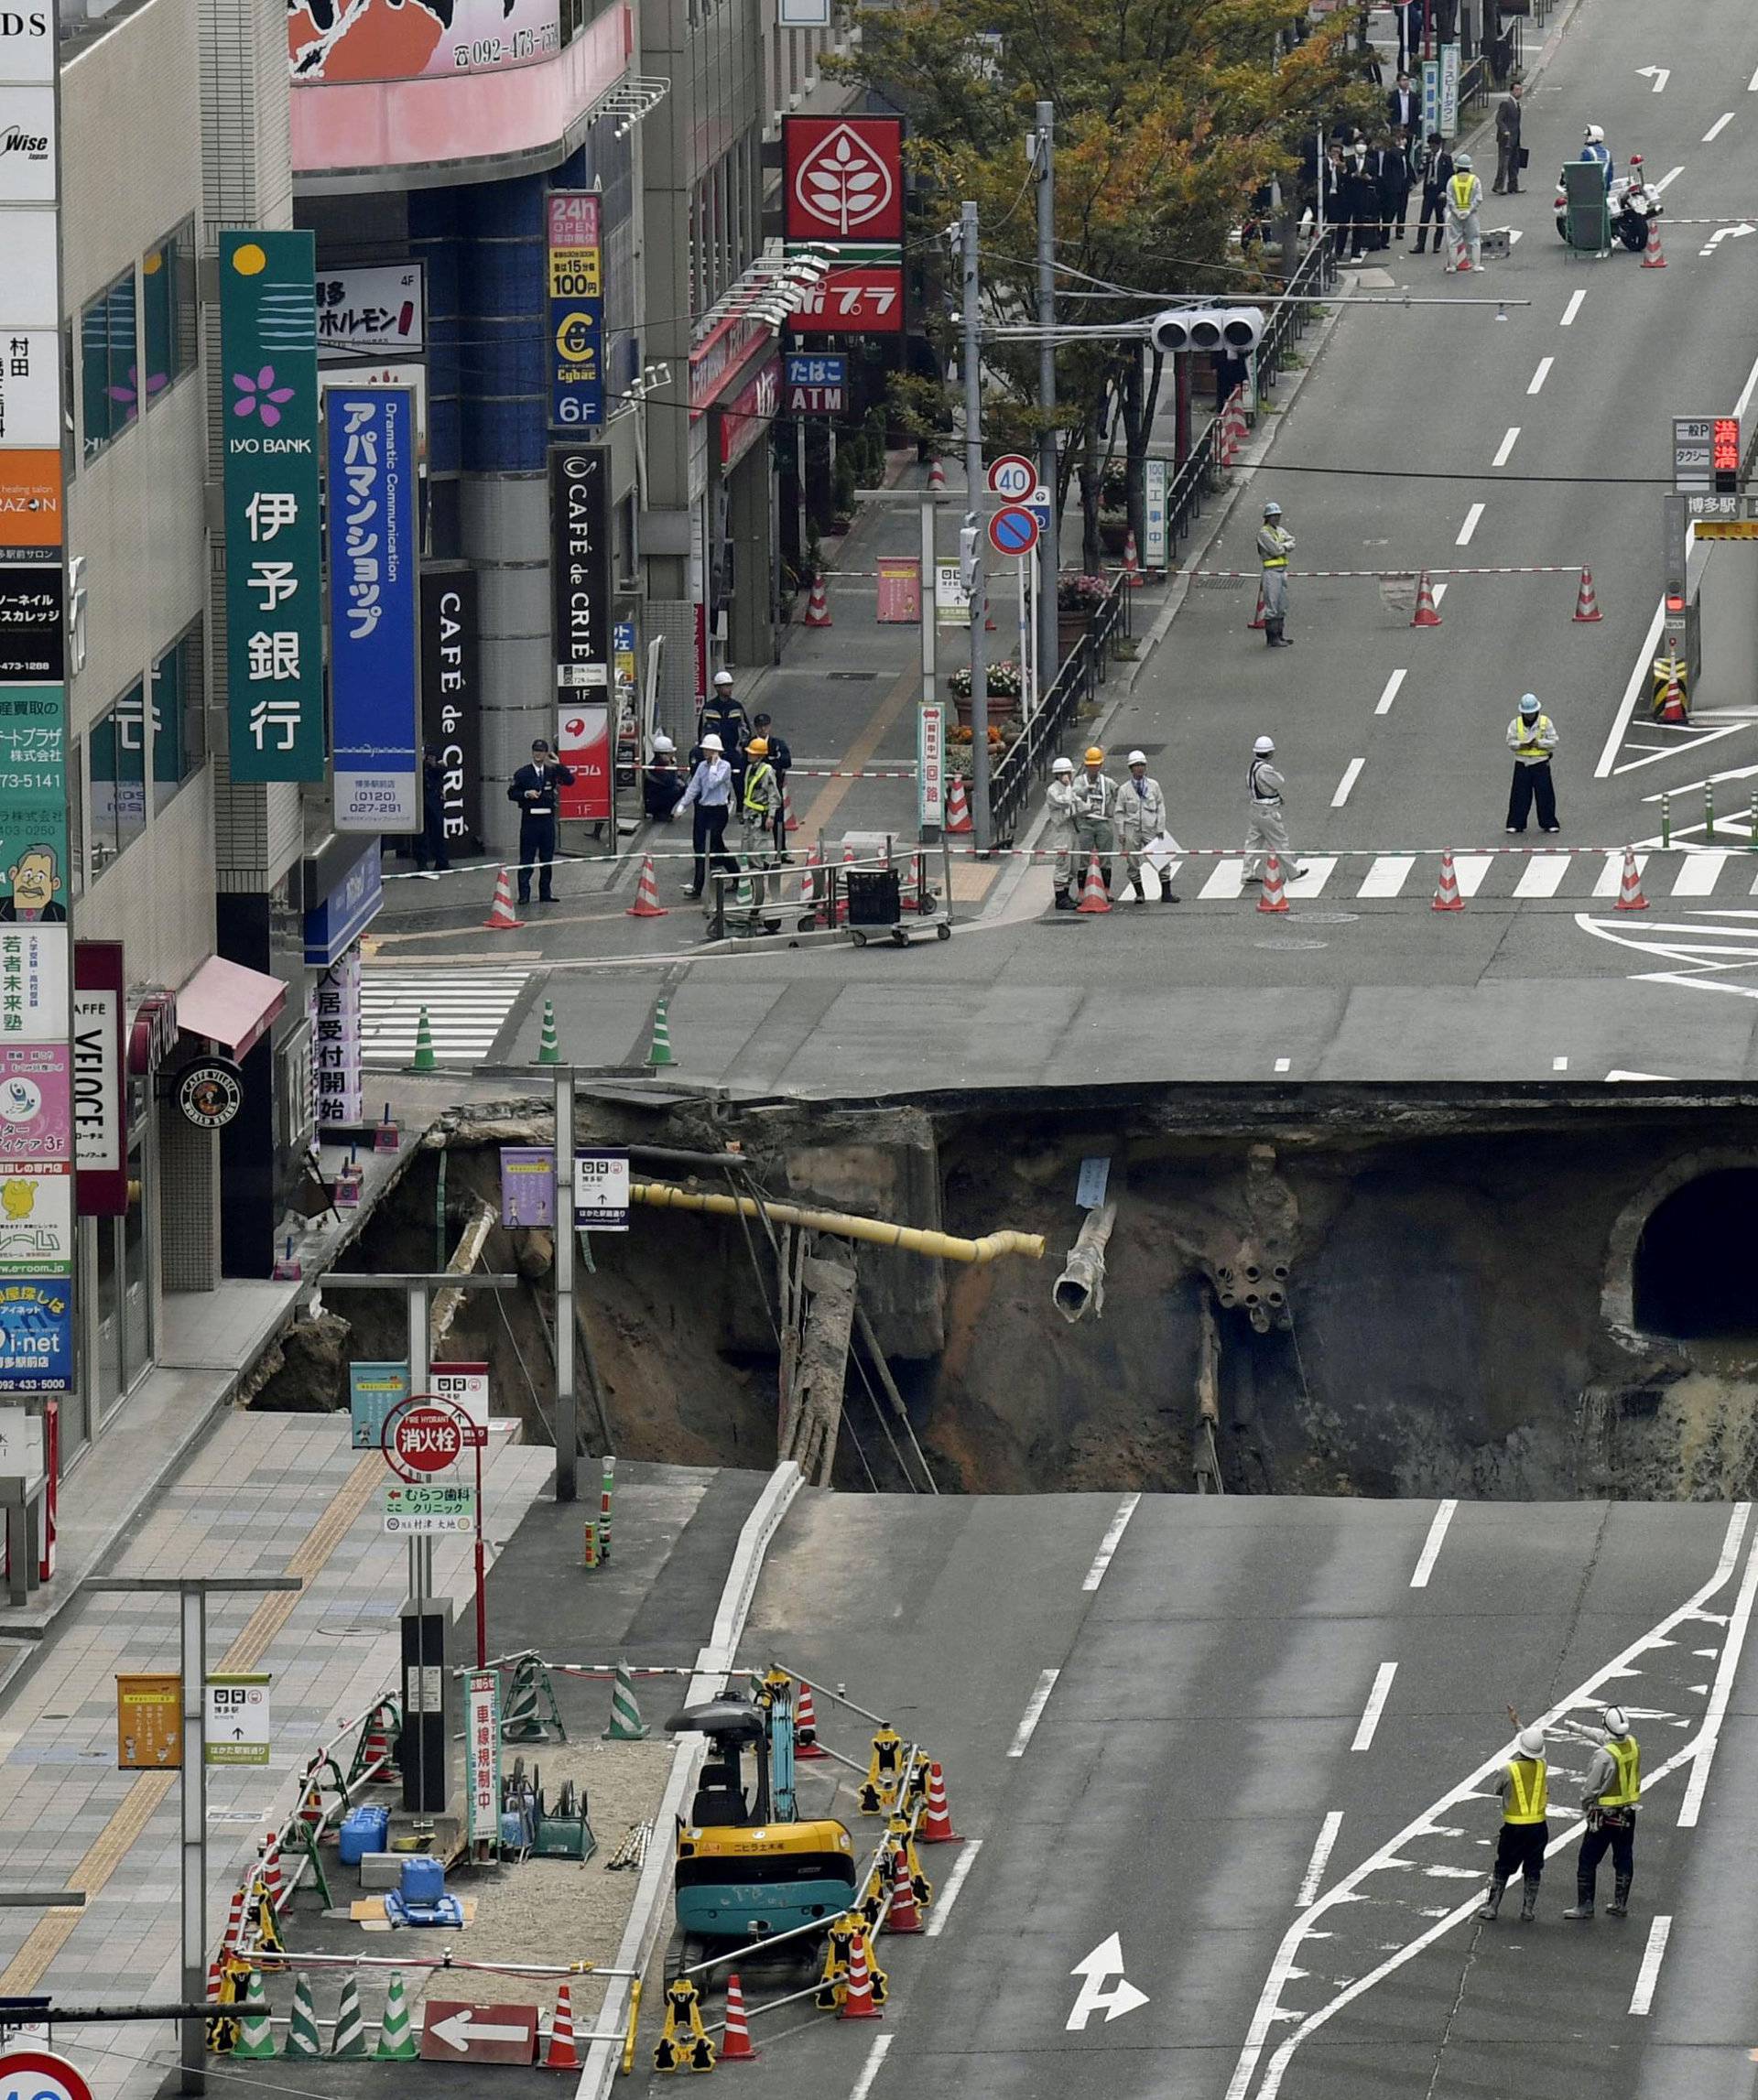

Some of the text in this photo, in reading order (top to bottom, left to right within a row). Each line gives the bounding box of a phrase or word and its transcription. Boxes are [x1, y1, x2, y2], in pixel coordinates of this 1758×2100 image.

[5, 134, 48, 151] Wise
[553, 199, 596, 221] 24h
[553, 222, 594, 232] OPEN
[401, 276, 414, 286] 4F
[553, 274, 597, 295] 100円
[319, 308, 396, 336] ホルモン
[10, 337, 29, 377] 村田
[558, 368, 596, 382] Cybac
[791, 361, 841, 381] たばこ
[791, 388, 841, 409] ATM
[559, 397, 595, 422] 6F
[1677, 424, 1709, 437] 一般P
[1715, 421, 1738, 443] 満
[231, 439, 311, 453] IYO BANK
[1677, 450, 1709, 462] タクシー
[1715, 445, 1738, 469] 満
[1000, 470, 1026, 490] 40
[385, 404, 399, 582] Dramatic Communication
[1688, 497, 1736, 513] 博多駅
[343, 403, 382, 639] アパマンショップ
[1149, 490, 1162, 544] 工事中
[569, 484, 594, 659] CAFÉ de CRIÉ
[244, 492, 300, 750] 伊予銀行
[575, 689, 591, 699] 1F
[440, 592, 469, 839] CAFÉ de CRIÉ
[10, 750, 62, 762] 株式会社
[0, 774, 60, 787] 73-5141
[355, 792, 396, 801] (0120)
[350, 804, 401, 812] 027-291
[577, 805, 591, 815] 1F
[3, 936, 23, 1031] 若者未来塾
[0, 1124, 29, 1136] ター
[45, 1135, 63, 1151] 3F
[0, 1356, 49, 1368] 多駅前店
[421, 1415, 449, 1423] HYDRANT
[401, 1427, 457, 1453] 消火栓
[405, 1488, 470, 1501] むらつ歯科
[386, 1503, 462, 1513] ここ クリニック
[477, 1705, 491, 1810] 車線規制中
